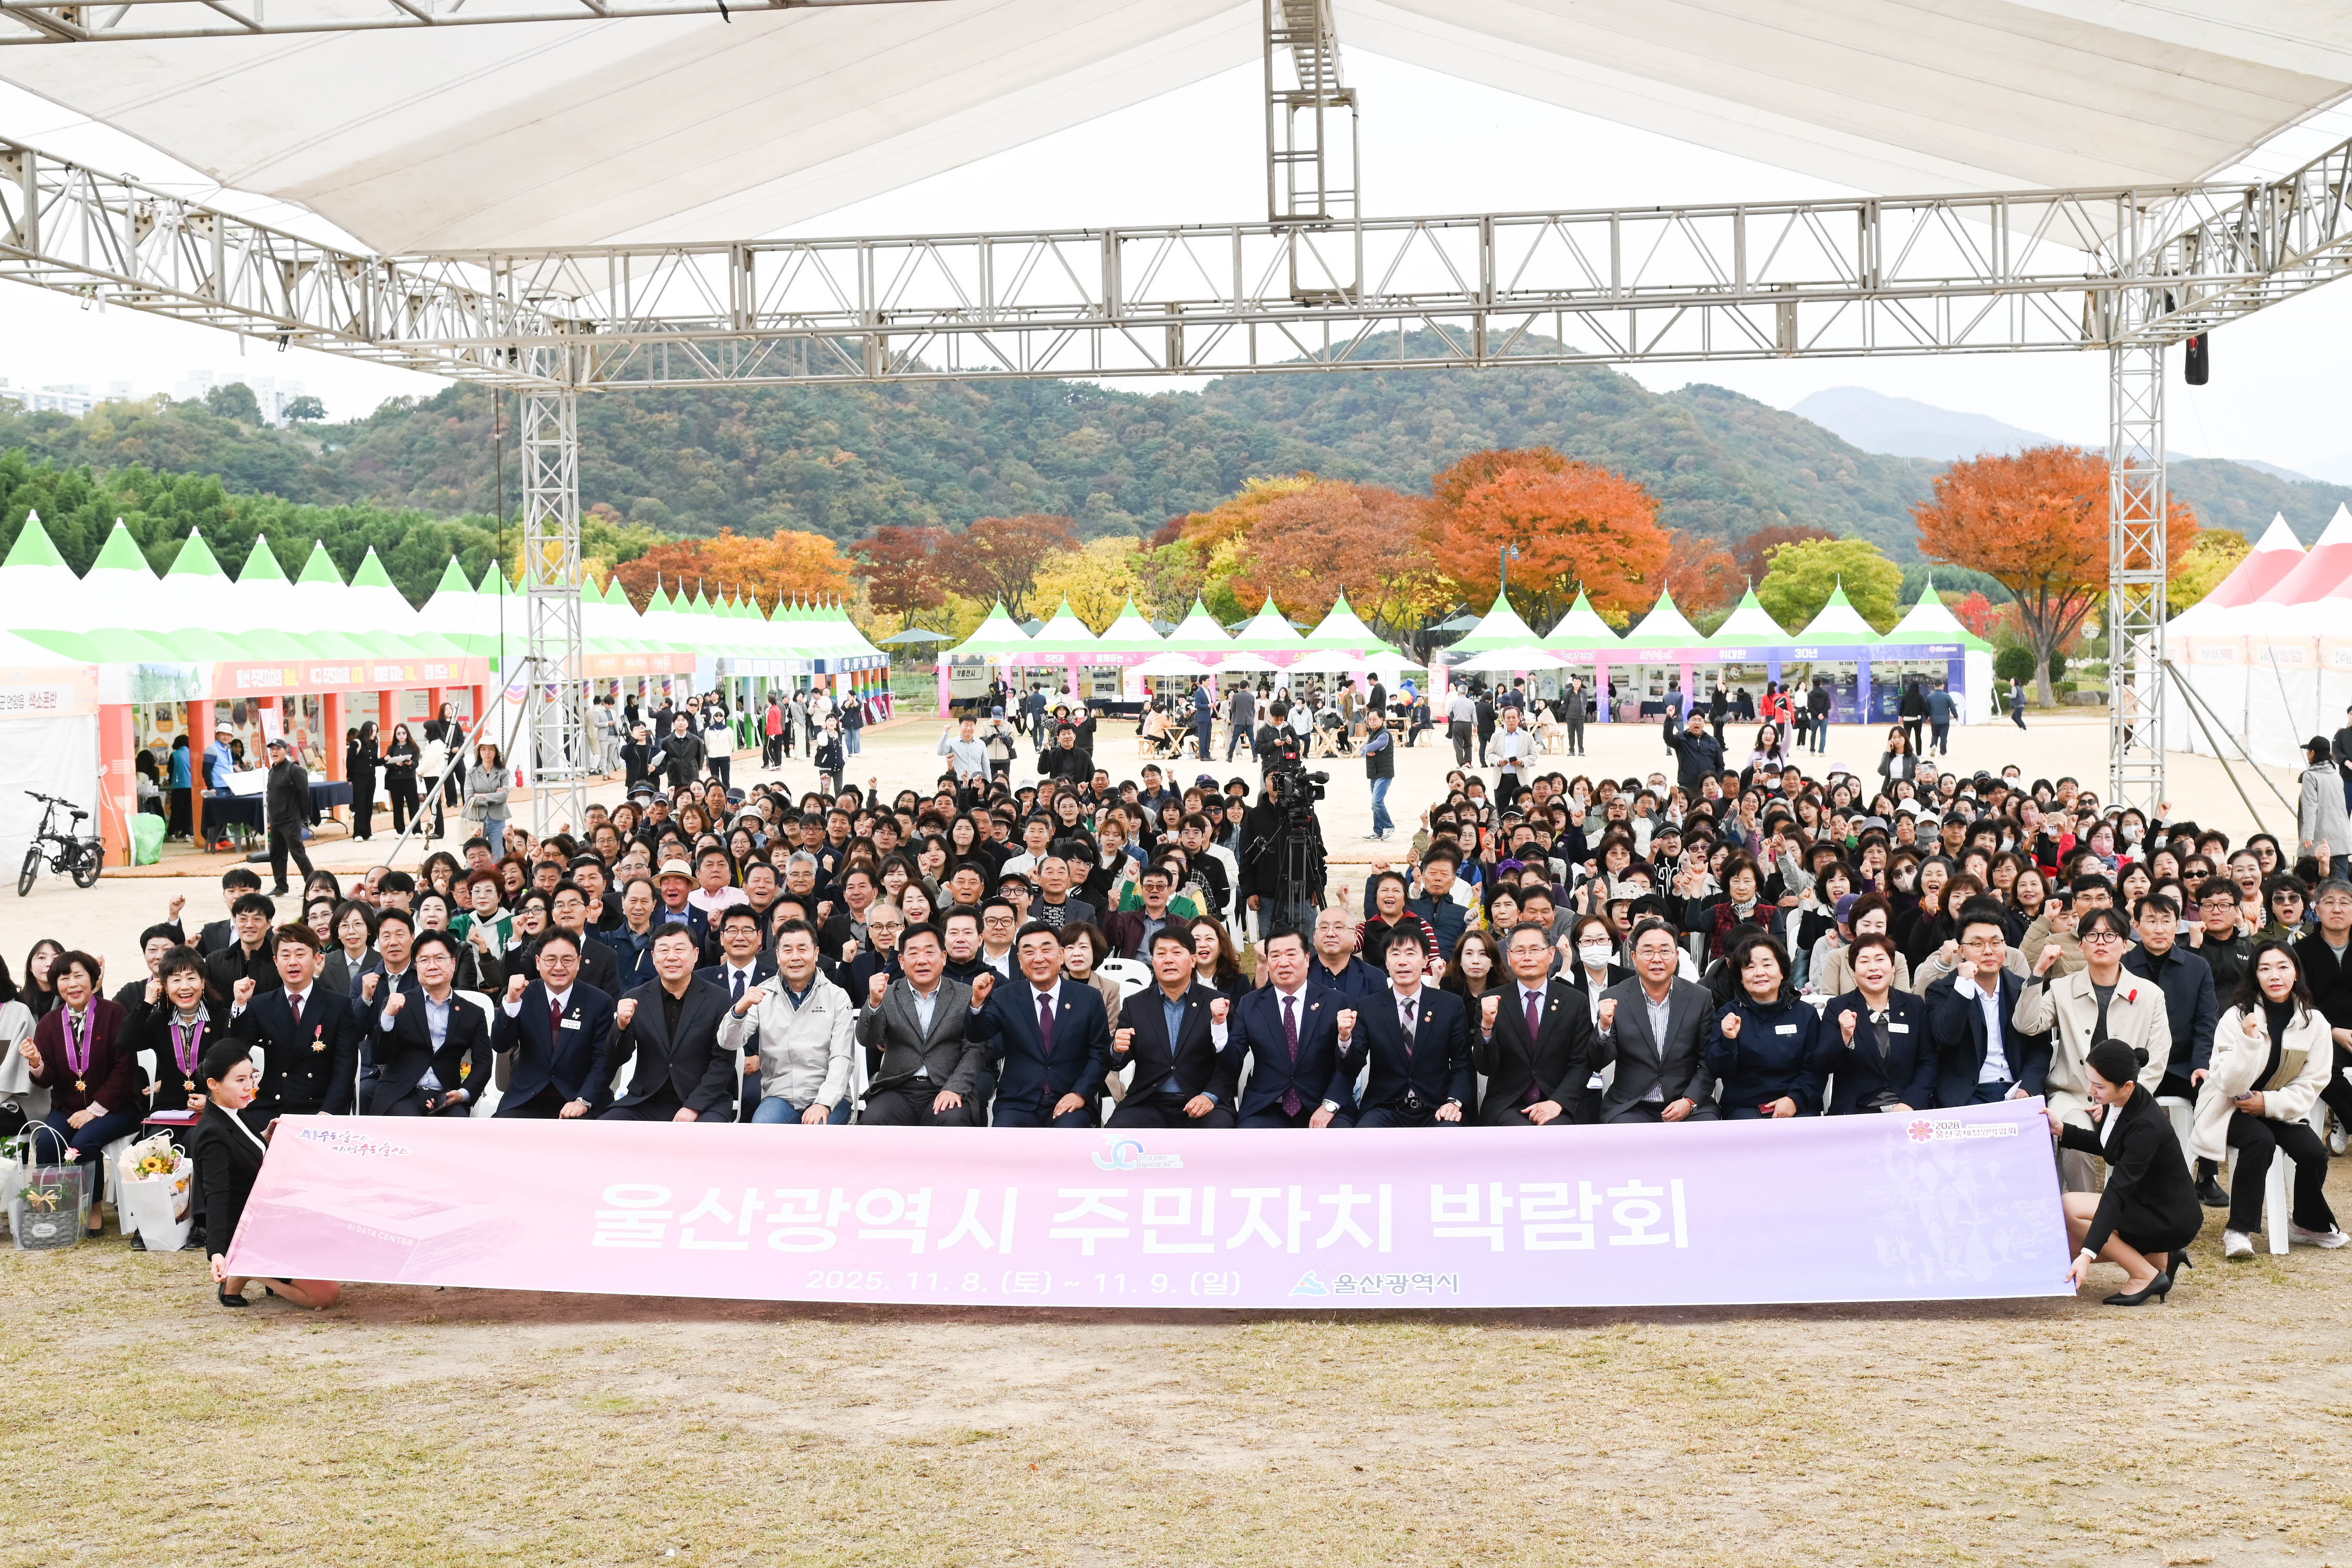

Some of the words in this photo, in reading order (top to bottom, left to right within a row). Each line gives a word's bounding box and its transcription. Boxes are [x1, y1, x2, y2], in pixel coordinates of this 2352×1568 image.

[1045, 654, 1065, 663] 주민과
[1097, 654, 1124, 663] 함께하는
[1719, 650, 1747, 659] 위대한
[1794, 648, 1818, 659] 30년
[237, 669, 250, 688] 울산
[7, 694, 24, 709] 언양읍
[29, 690, 57, 709] 색소폰반
[1936, 1121, 1959, 1130] 2028
[1936, 1126, 2016, 1138] 울산국제정원박람회
[592, 1183, 1018, 1254] 울산광역시
[1049, 1184, 1392, 1256] 주민자치
[1431, 1179, 1689, 1252] 박람회
[356, 1226, 376, 1237] DATA
[378, 1232, 413, 1247] CENTER
[806, 1270, 890, 1291] 2025.
[907, 1271, 949, 1292] 11.
[963, 1272, 988, 1292] 8.
[1002, 1271, 1052, 1296] (토)
[1094, 1273, 1137, 1294] 11.
[1150, 1274, 1177, 1294] 9.
[1191, 1271, 1241, 1296] (일)
[1332, 1273, 1460, 1296] 울산광역시
